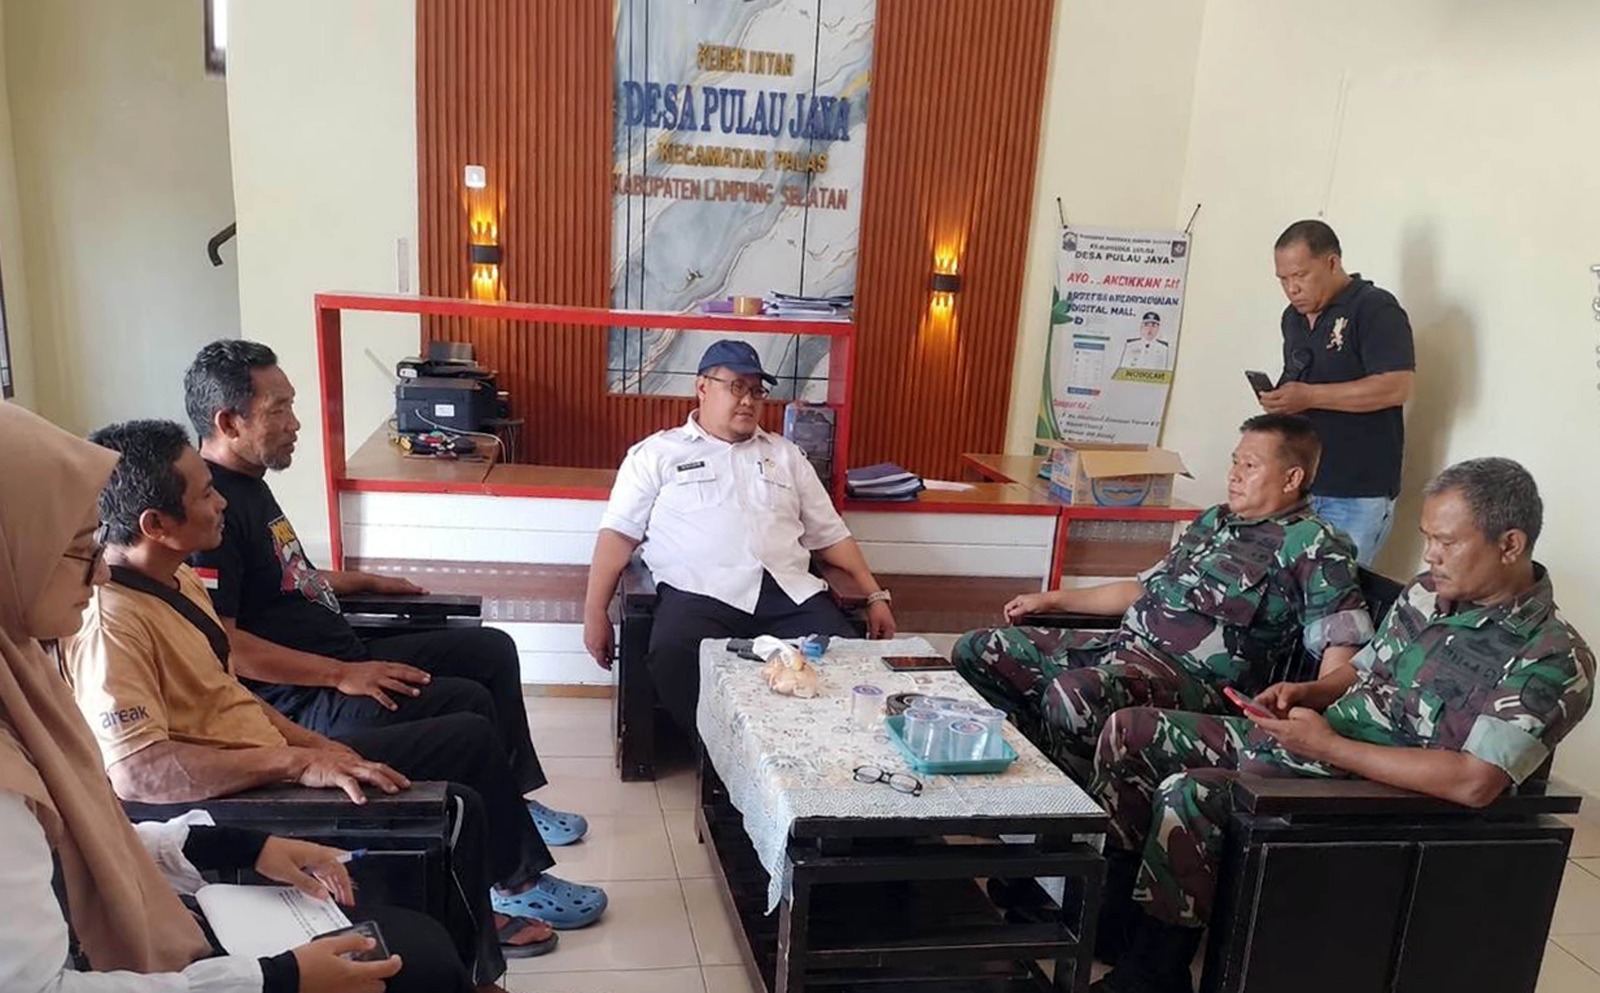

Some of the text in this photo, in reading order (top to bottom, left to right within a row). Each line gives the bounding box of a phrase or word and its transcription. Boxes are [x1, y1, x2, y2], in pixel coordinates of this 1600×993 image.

[623, 81, 850, 141] DESA PULAU JAYA
[658, 141, 828, 173] KECAMATAN PALAS
[704, 179, 773, 204] LAMPUNG
[780, 184, 848, 210] SELATAN
[1075, 251, 1170, 265] DESA PULAU JAYA
[99, 705, 150, 729] areak
